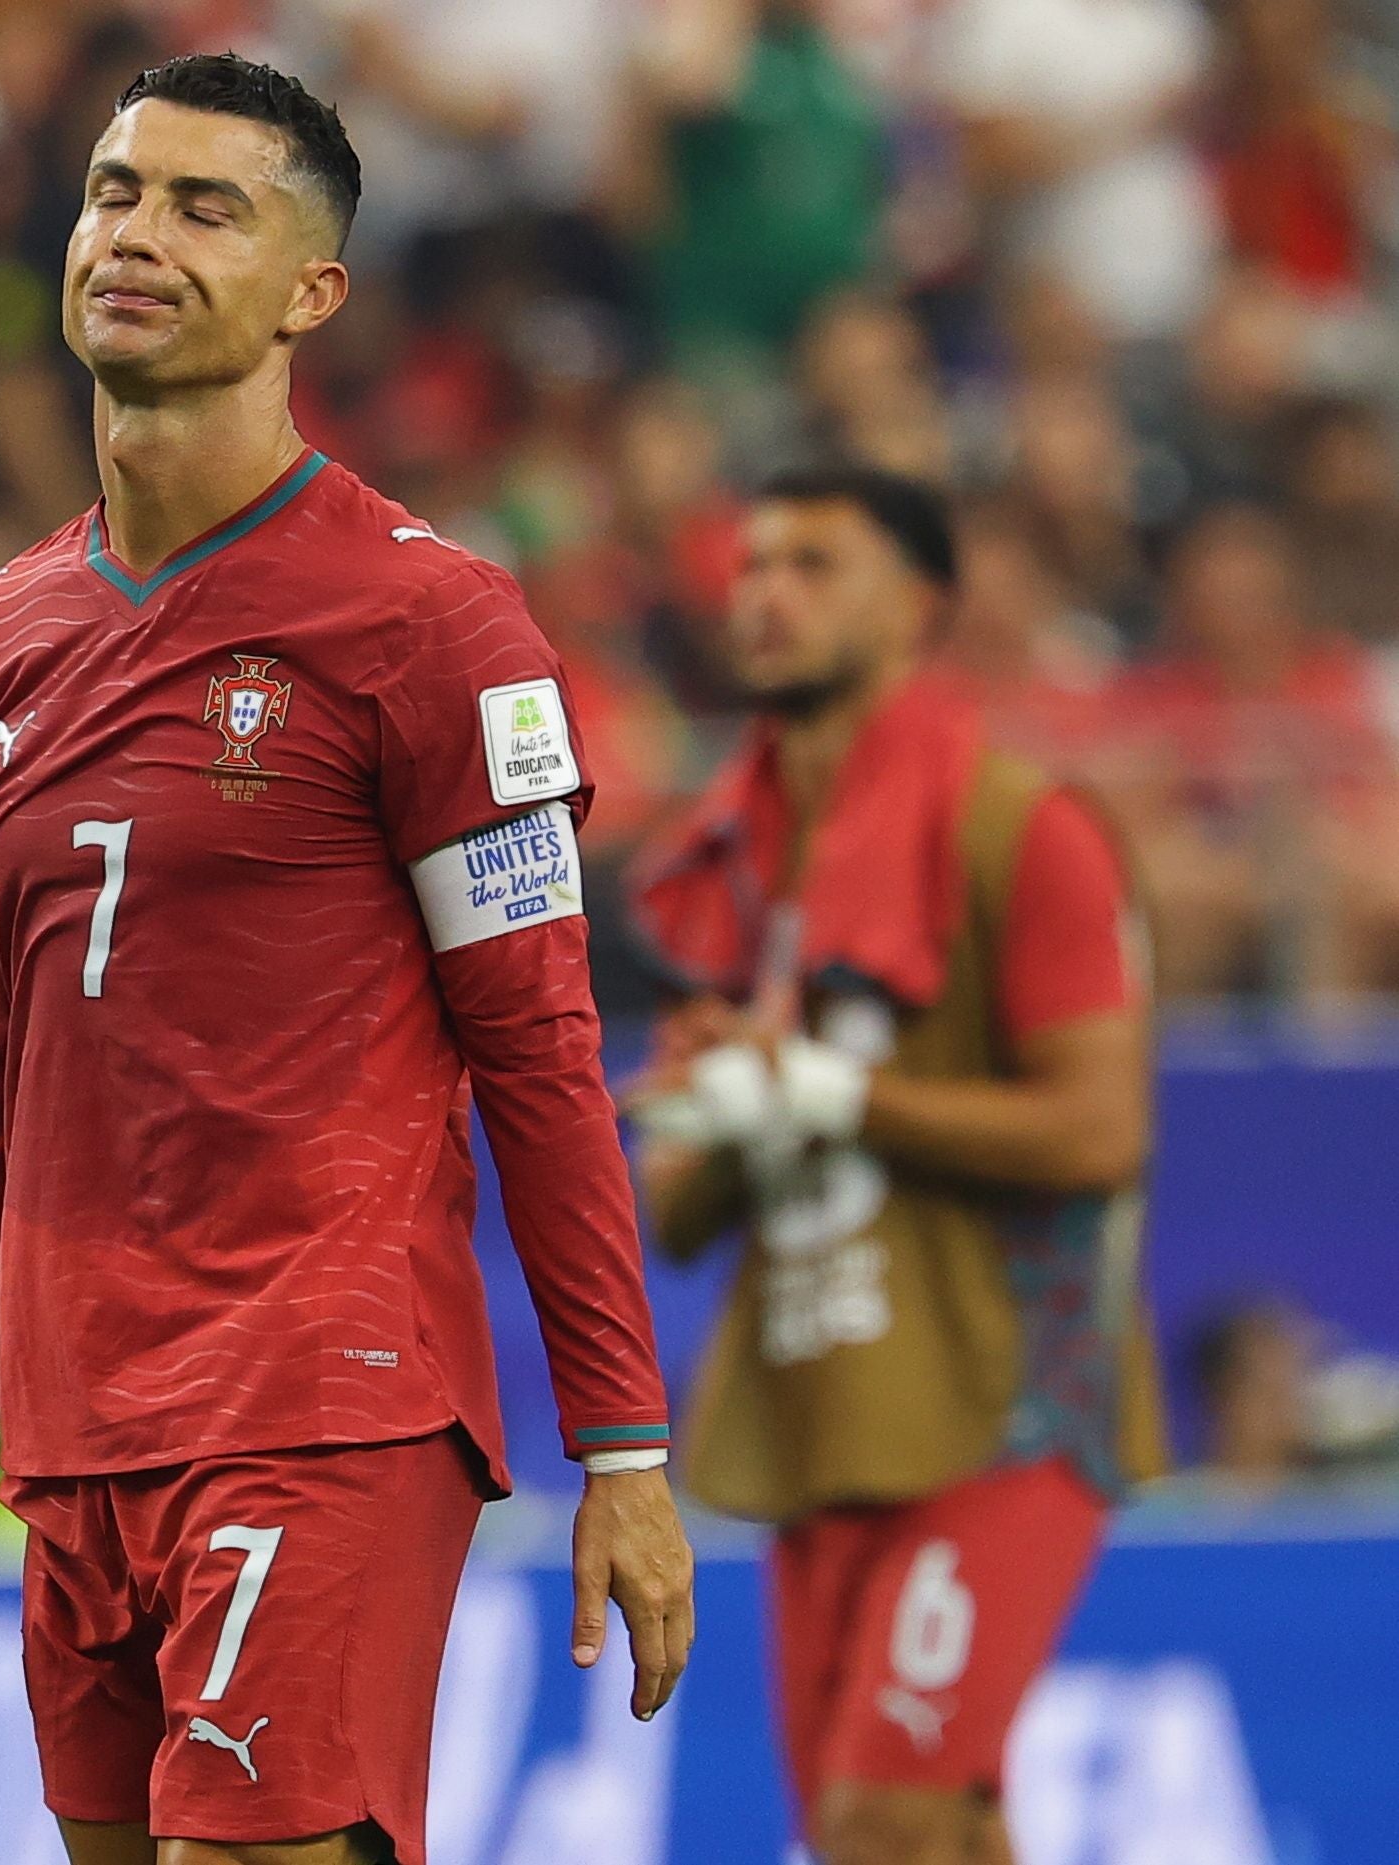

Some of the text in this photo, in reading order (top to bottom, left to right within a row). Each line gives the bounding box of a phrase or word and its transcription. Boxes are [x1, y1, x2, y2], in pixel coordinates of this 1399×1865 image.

[506, 753, 563, 777] EDUCATION
[528, 776, 550, 787] FIFA
[465, 830, 562, 880] UNITES
[73, 818, 133, 998] 7
[466, 859, 568, 908] the World
[509, 898, 545, 918] FIFA
[199, 1524, 284, 1701] 7
[890, 1540, 975, 1693] 6
